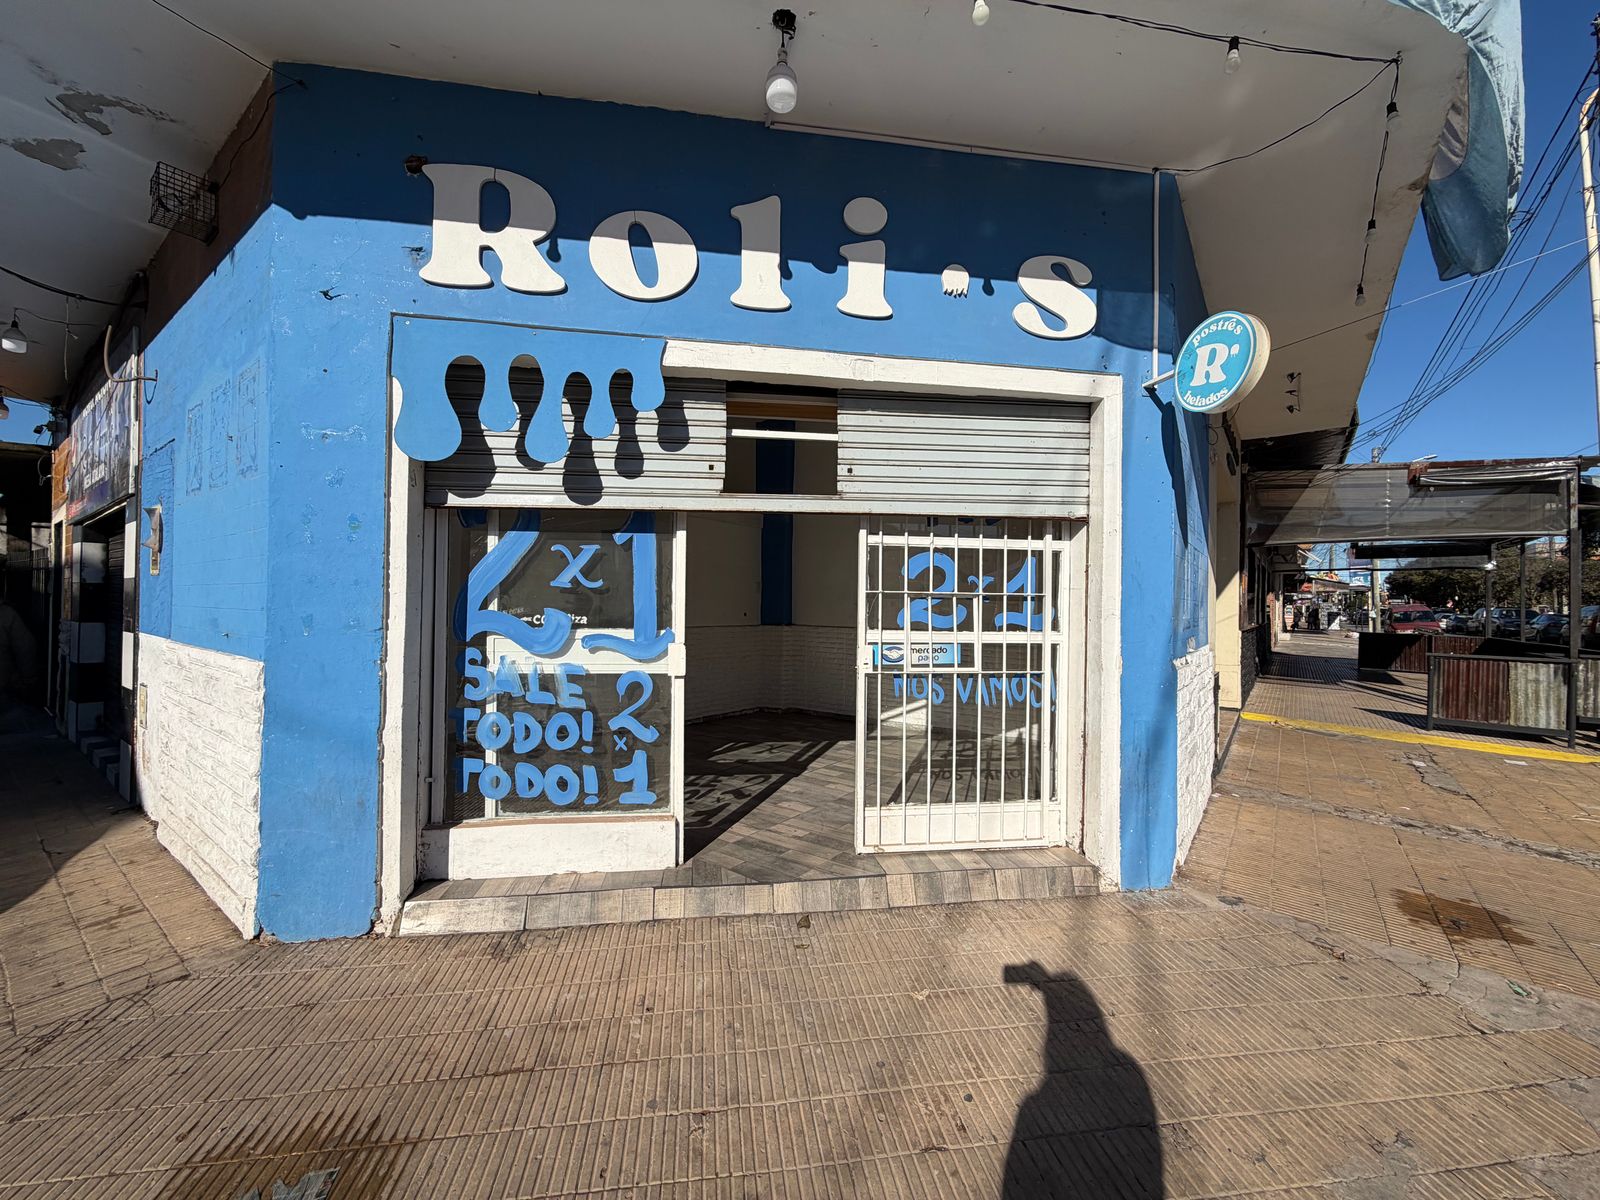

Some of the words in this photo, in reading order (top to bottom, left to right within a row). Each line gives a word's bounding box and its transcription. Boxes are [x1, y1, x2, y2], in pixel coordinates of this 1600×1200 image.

[1183, 387, 1229, 406] helados
[455, 647, 588, 709] SALE
[918, 654, 940, 663] pao
[893, 668, 945, 705] NOS
[449, 708, 595, 754] TODO!
[453, 758, 600, 806] TODO!
